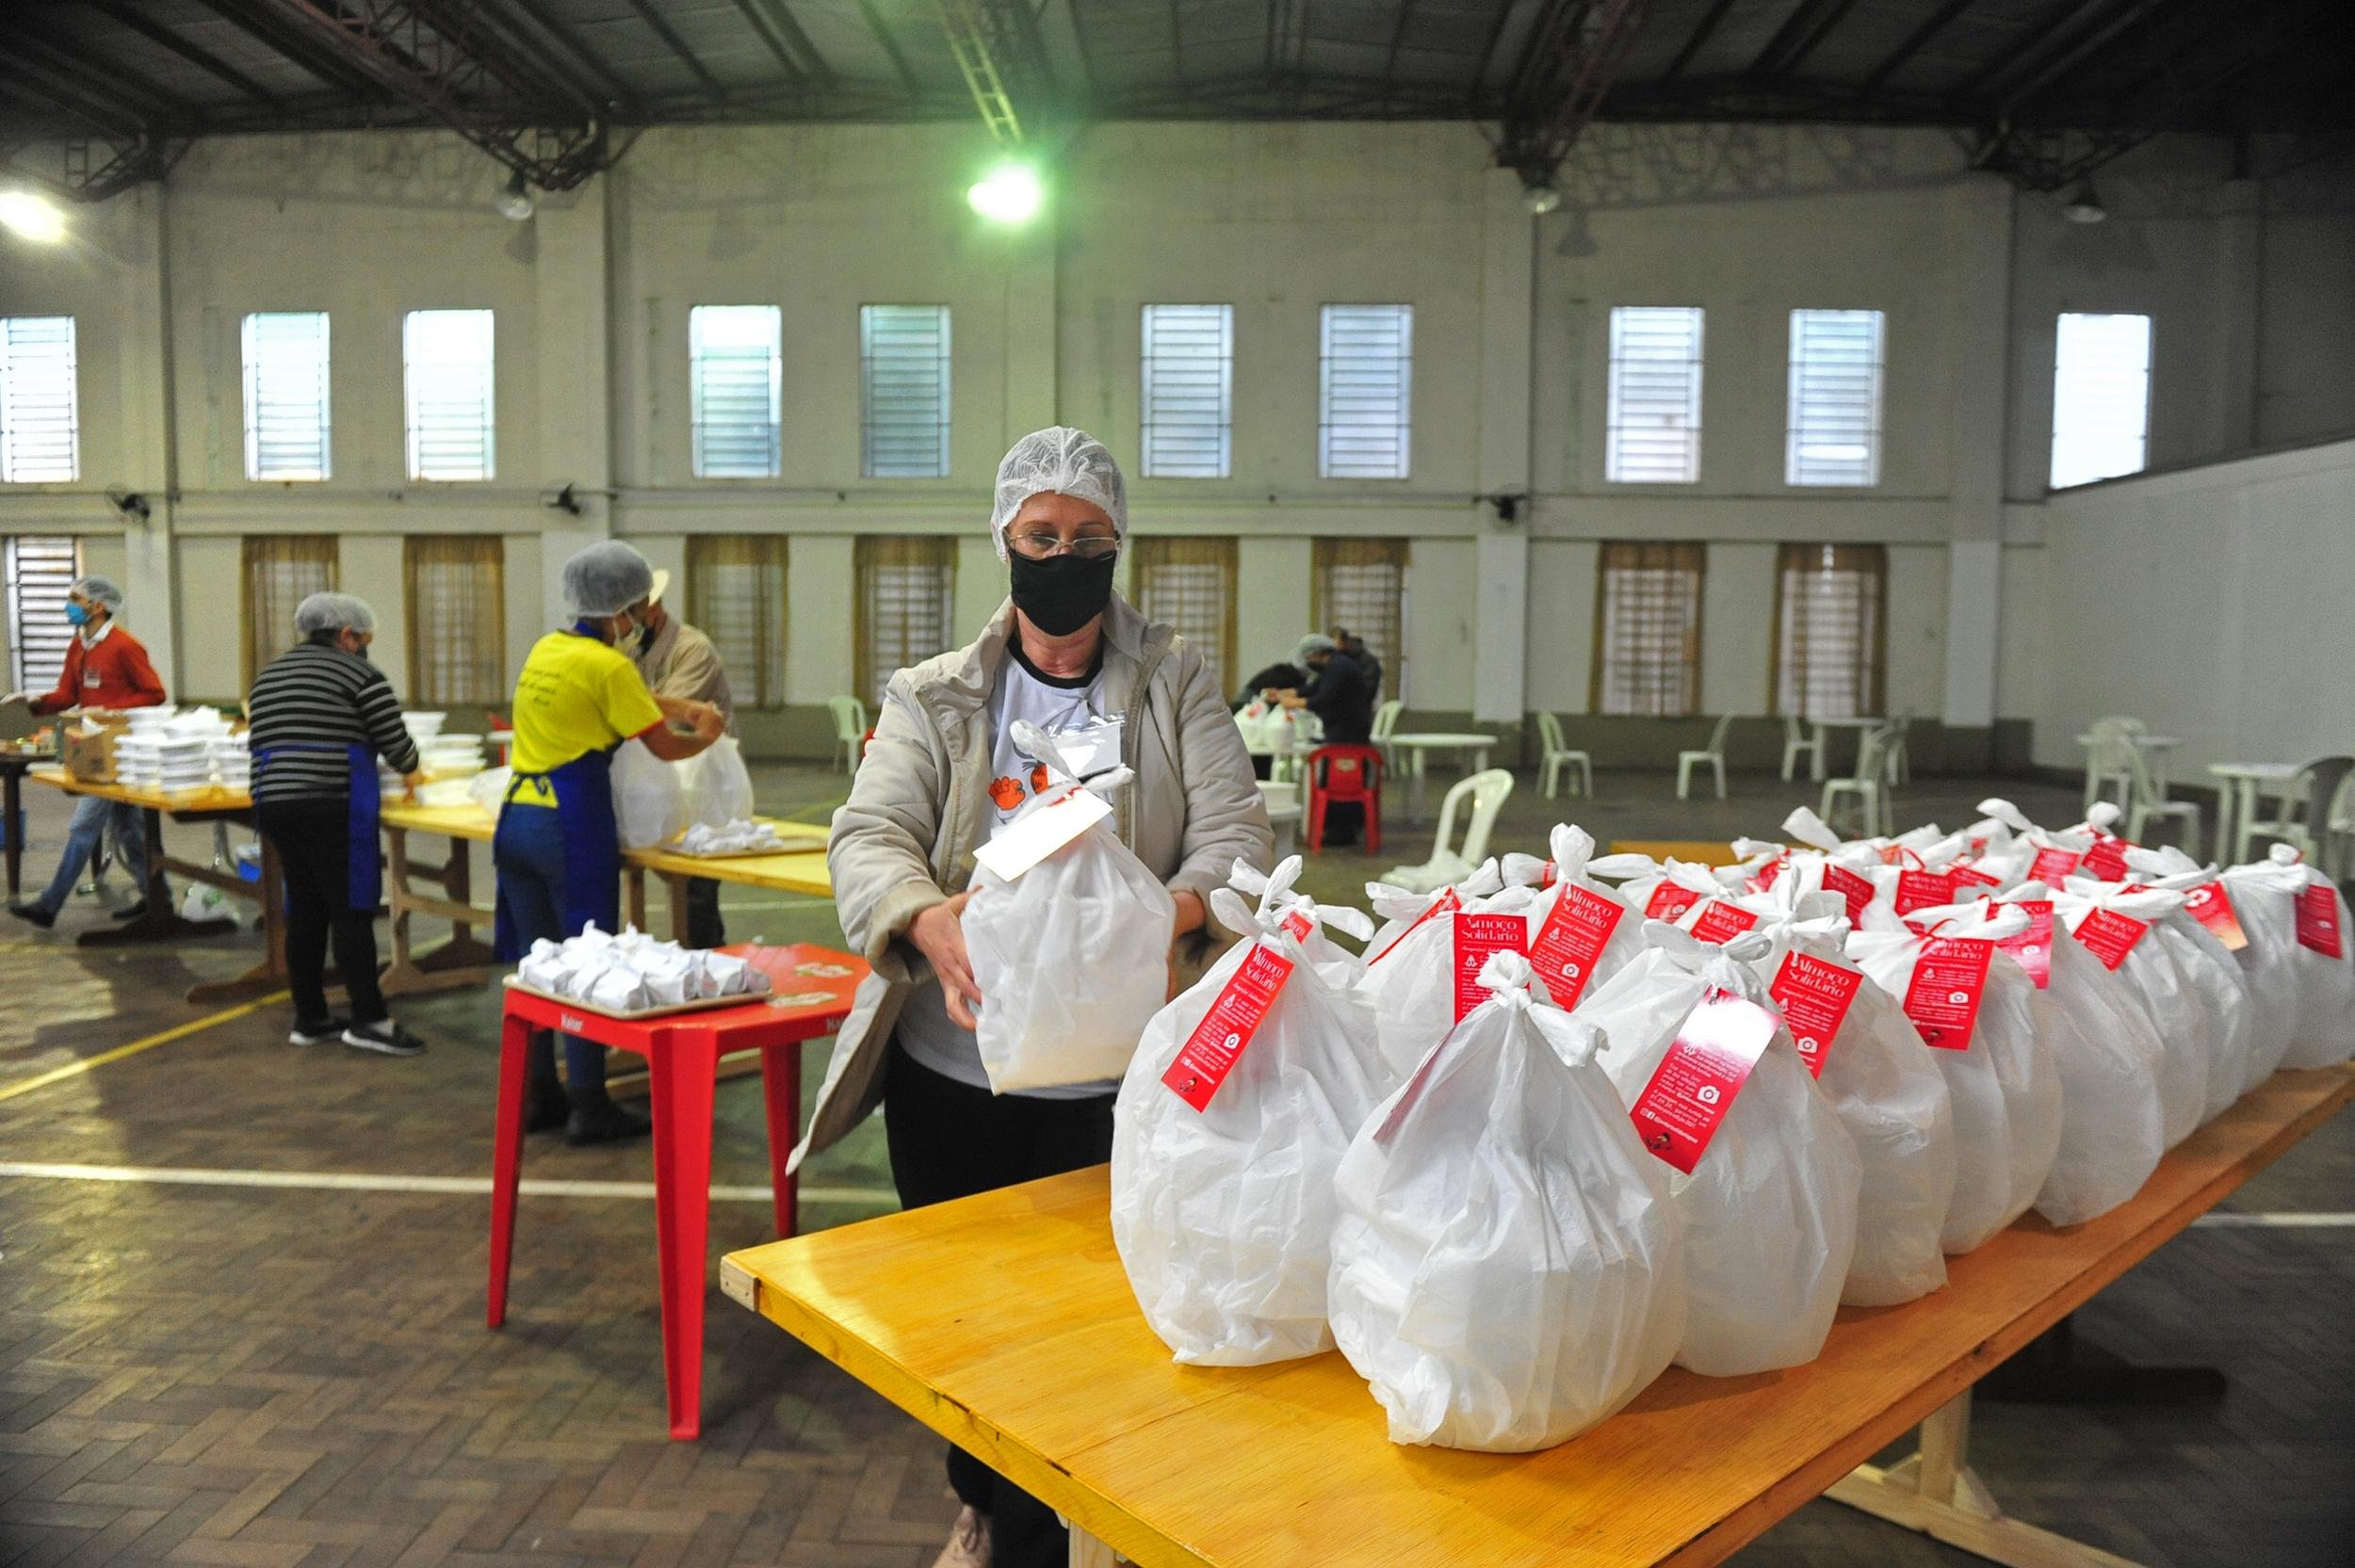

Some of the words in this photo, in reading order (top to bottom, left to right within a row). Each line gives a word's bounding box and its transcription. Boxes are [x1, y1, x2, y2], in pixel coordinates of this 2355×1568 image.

[1563, 899, 1607, 929] Solidário
[1572, 890, 1613, 917] Almoço
[1461, 928, 1519, 942] Solidário
[1788, 969, 1845, 998] Solidário
[1799, 959, 1850, 987] Almoço
